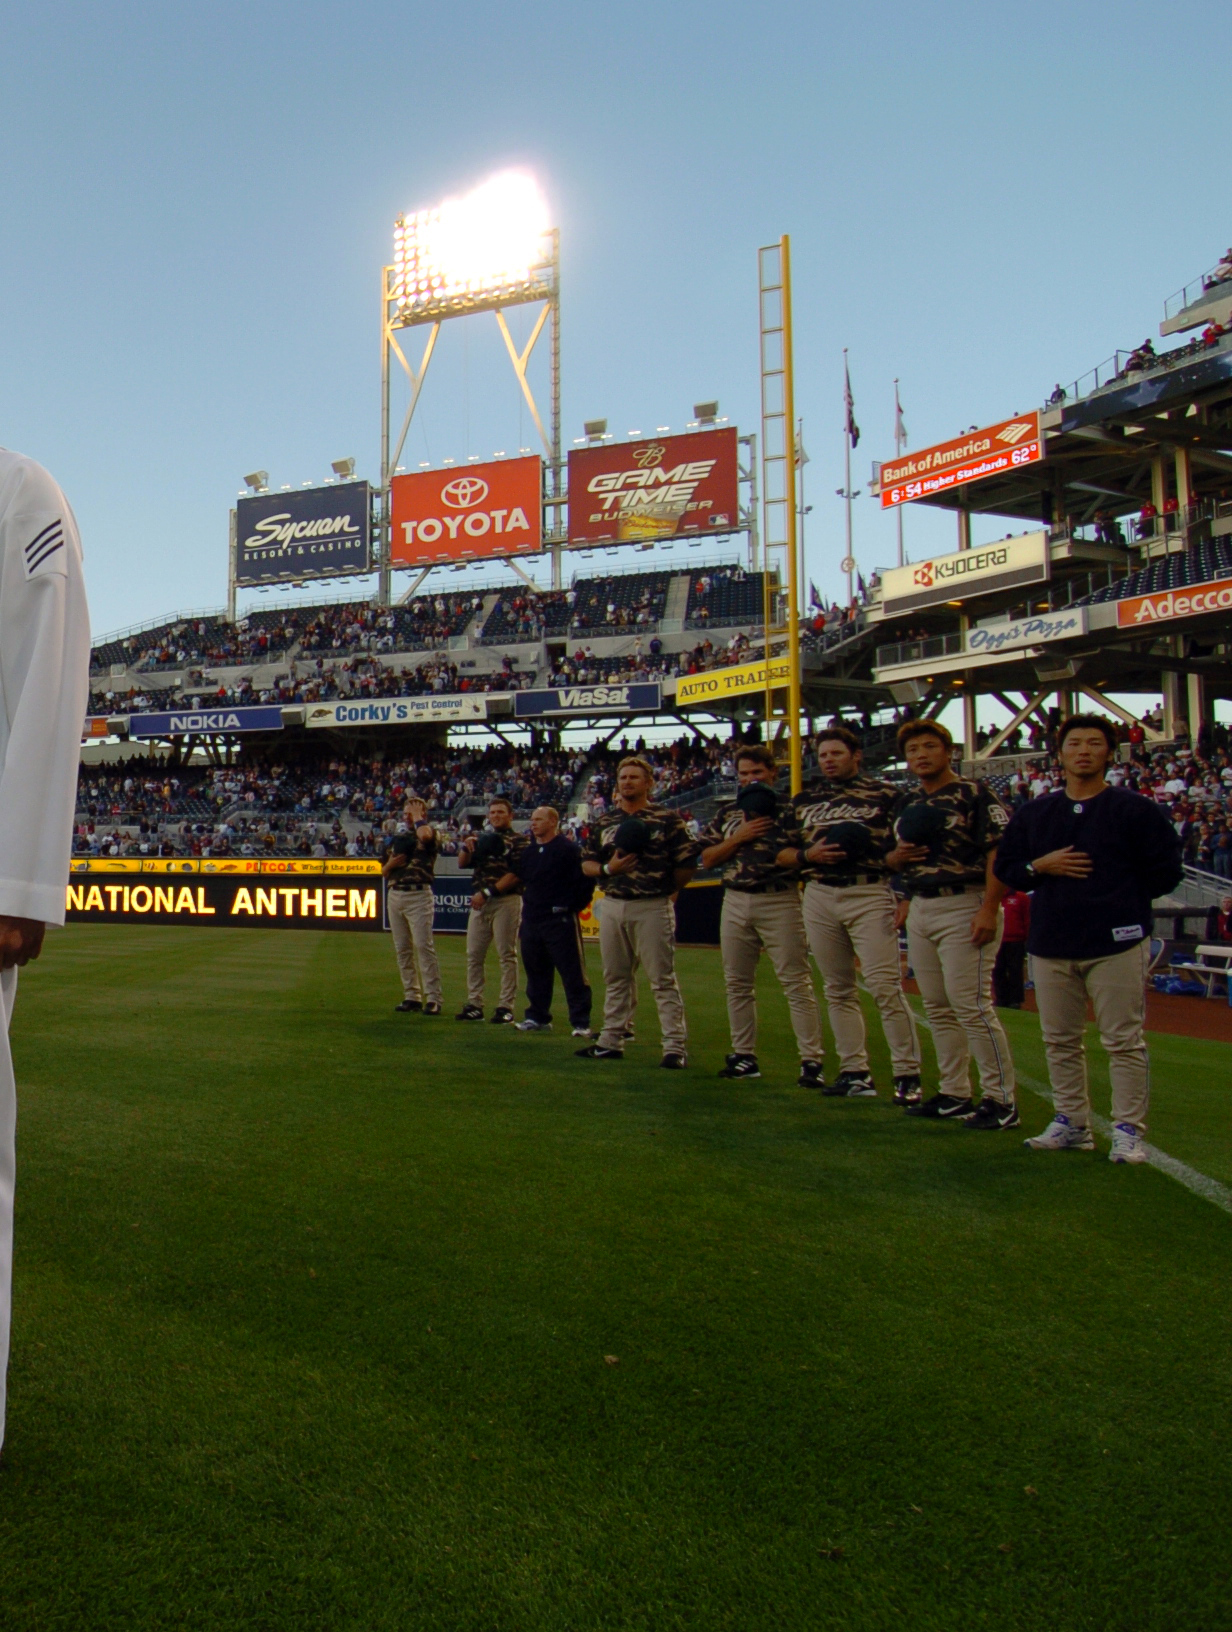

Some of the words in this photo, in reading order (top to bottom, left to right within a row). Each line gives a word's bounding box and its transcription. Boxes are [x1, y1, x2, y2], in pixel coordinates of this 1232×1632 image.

[587, 459, 717, 492] GAME
[883, 463, 917, 483] Bank
[917, 453, 933, 472] of
[933, 438, 991, 467] America
[598, 481, 700, 510] TIME
[891, 481, 923, 503] 6:54
[923, 474, 956, 491] Higher
[956, 457, 1008, 480] Standards
[401, 507, 530, 544] TOYOTA
[588, 500, 714, 523] BUDWEISER
[244, 513, 360, 549] Sycuan
[244, 549, 293, 560] RESORT
[297, 546, 305, 554] &
[310, 540, 361, 553] CASINO
[1134, 587, 1232, 622] Adecco
[1022, 619, 1078, 638] Pizza
[679, 679, 719, 697] AUTO
[723, 665, 790, 688] TRADER
[170, 714, 241, 730] NOKIA
[335, 703, 408, 722] Corky's
[411, 701, 429, 710] Pest
[431, 699, 463, 709] Control
[800, 801, 879, 828] Padres
[66, 885, 215, 914] NATIONAL
[230, 887, 377, 918] ANTHEM
